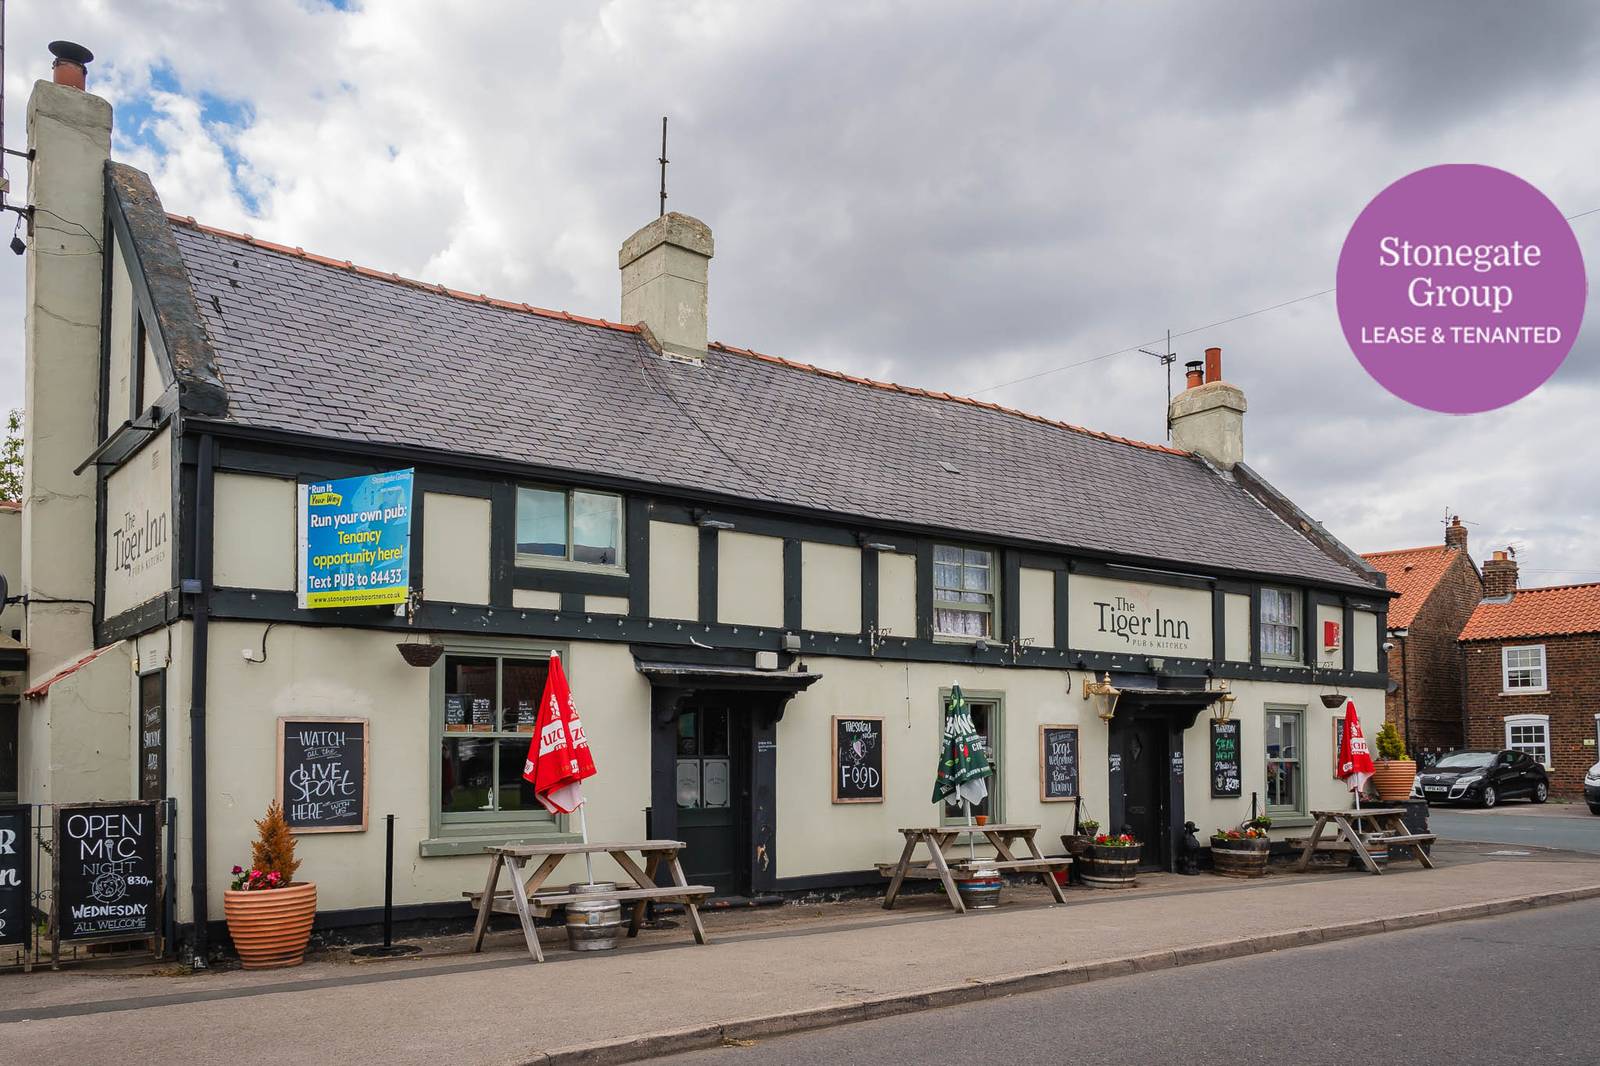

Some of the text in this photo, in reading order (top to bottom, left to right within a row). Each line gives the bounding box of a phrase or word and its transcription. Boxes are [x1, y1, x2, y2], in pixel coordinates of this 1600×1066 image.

[311, 485, 325, 493] Run
[311, 494, 341, 505] Your Way
[124, 511, 135, 532] The
[310, 514, 332, 527] Run
[334, 512, 358, 529] your
[360, 509, 381, 523] own
[113, 527, 144, 576] Tiger
[144, 509, 167, 554] Inn
[338, 530, 381, 546] Tenancy
[313, 545, 403, 570] opportunity here!
[309, 569, 402, 589] Text PUB to 84433
[1115, 596, 1135, 612] The
[1093, 602, 1190, 643] Tiger Inn
[1132, 639, 1147, 647] PUB
[1156, 642, 1188, 650] KITCHEN
[300, 731, 345, 746] WATCH
[1052, 742, 1071, 758] Dogs
[300, 763, 341, 780] LIVE
[841, 766, 880, 788] FOOD
[289, 769, 356, 802] Sport
[292, 802, 324, 820] HERE
[67, 814, 142, 839] OPEN
[80, 837, 138, 862] MIC
[82, 861, 136, 876] NIGHT
[71, 903, 148, 919] WEDNESDAY
[74, 917, 146, 933] ALL WELCOME
